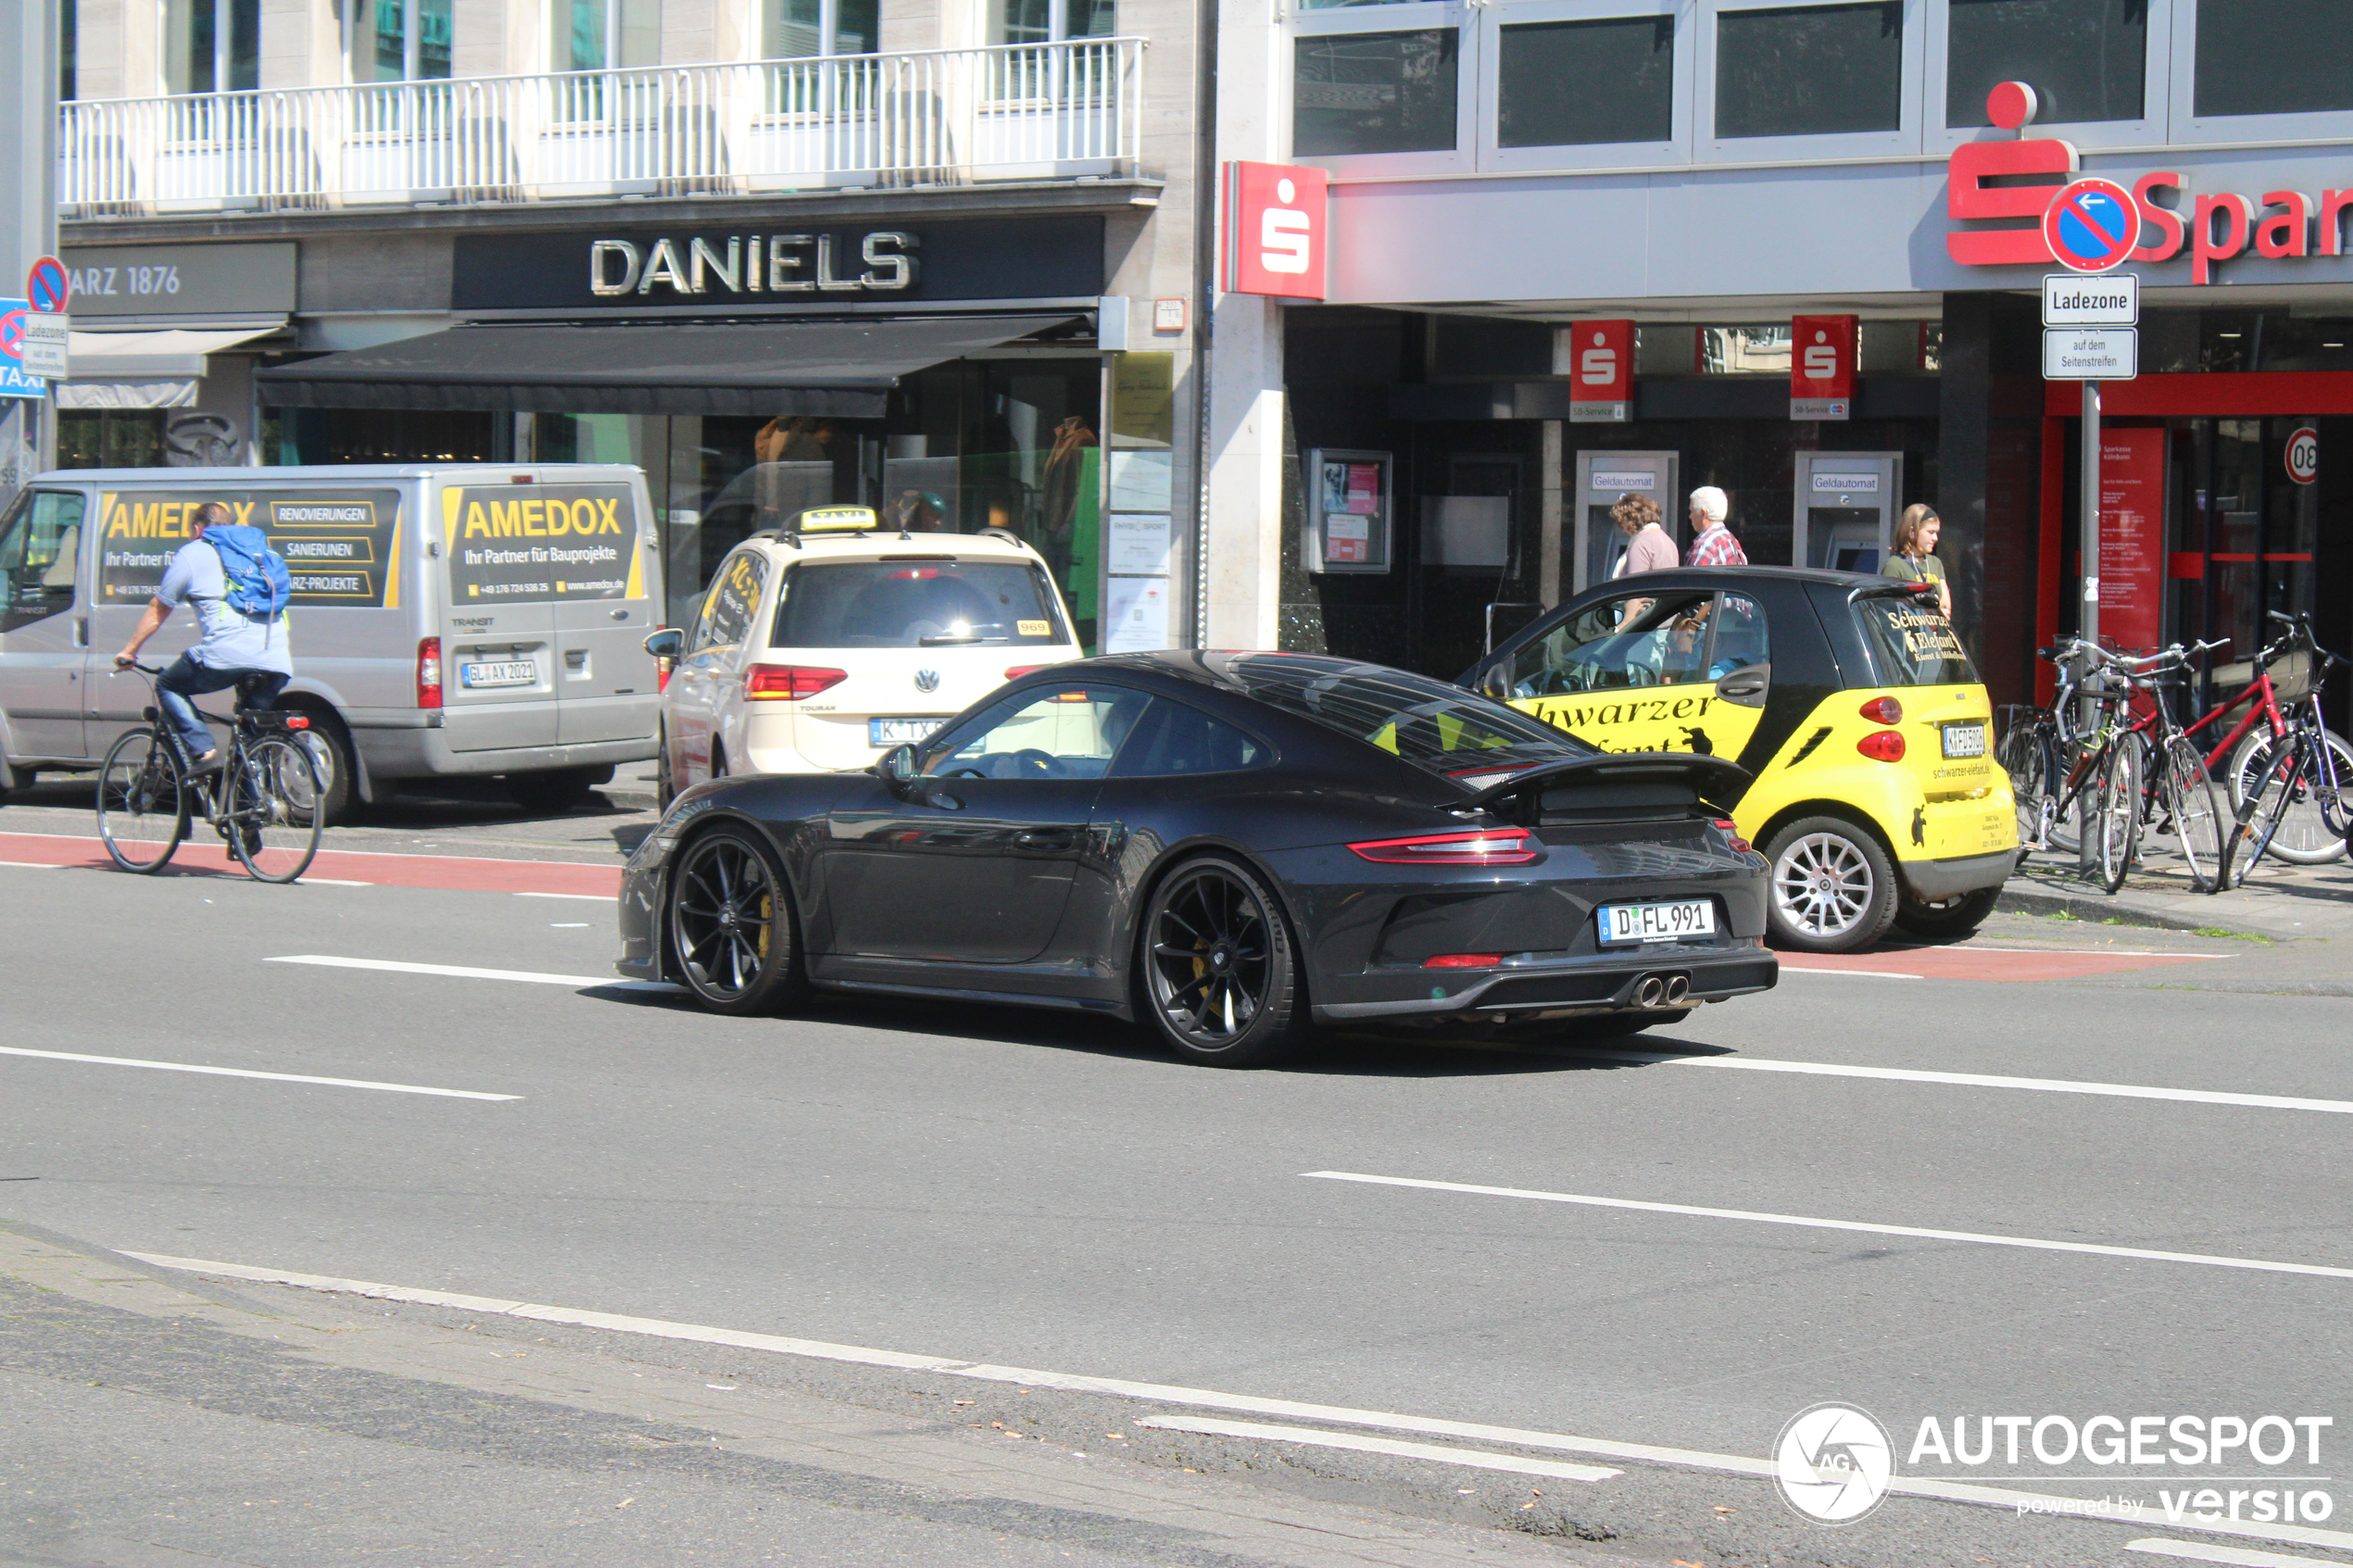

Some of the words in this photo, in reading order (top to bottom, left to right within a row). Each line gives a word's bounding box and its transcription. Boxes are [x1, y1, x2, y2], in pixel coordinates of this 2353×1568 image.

[591, 232, 915, 295] DANIELS
[68, 266, 118, 295] ARZ
[127, 265, 181, 295] 1876
[2053, 292, 2128, 309] Ladezone
[26, 323, 66, 339] Ladezone
[2073, 339, 2087, 351] auf
[2089, 339, 2106, 351] dem
[2061, 356, 2117, 368] Seitenstreifen
[1572, 406, 1613, 416] SB-Service
[1794, 405, 1829, 413] SB-Service
[1593, 475, 1653, 488] Geldautomat
[1815, 477, 1876, 489] Geldautomat
[279, 507, 366, 521] RENOVIERUNGEN
[464, 498, 623, 538] AMEDOX
[286, 542, 353, 557] SANIERUNEN
[465, 550, 483, 565] Ihr
[485, 548, 530, 564] Partner
[531, 546, 548, 562] für
[550, 545, 618, 565] Bauprojekte
[106, 551, 120, 567] Ihr
[122, 550, 161, 567] Partner
[164, 549, 175, 567] fü
[288, 576, 359, 591] ARZ-PROJEKTE
[480, 585, 494, 595] +49
[495, 584, 509, 594] 176
[510, 583, 524, 593] 724
[525, 583, 539, 593] 536
[539, 583, 549, 592] 25
[566, 579, 625, 592] www.amedox.de
[14, 606, 48, 615] TRANSIT
[451, 617, 495, 627] TRANSIT
[1020, 623, 1046, 632] 969
[1915, 632, 1956, 651] Elefant
[1914, 653, 1935, 662] Kunst
[1935, 651, 1942, 659] &
[469, 665, 484, 681] GL
[492, 664, 507, 680] AX
[509, 662, 535, 680] 2021
[1535, 696, 1718, 729] hwarzer
[883, 721, 894, 738] K
[1948, 730, 1955, 750] K
[1932, 764, 1991, 780] schwarzer-elefant.de
[1617, 909, 1630, 935] D
[1642, 906, 1668, 934] FL
[1670, 904, 1705, 932] 991
